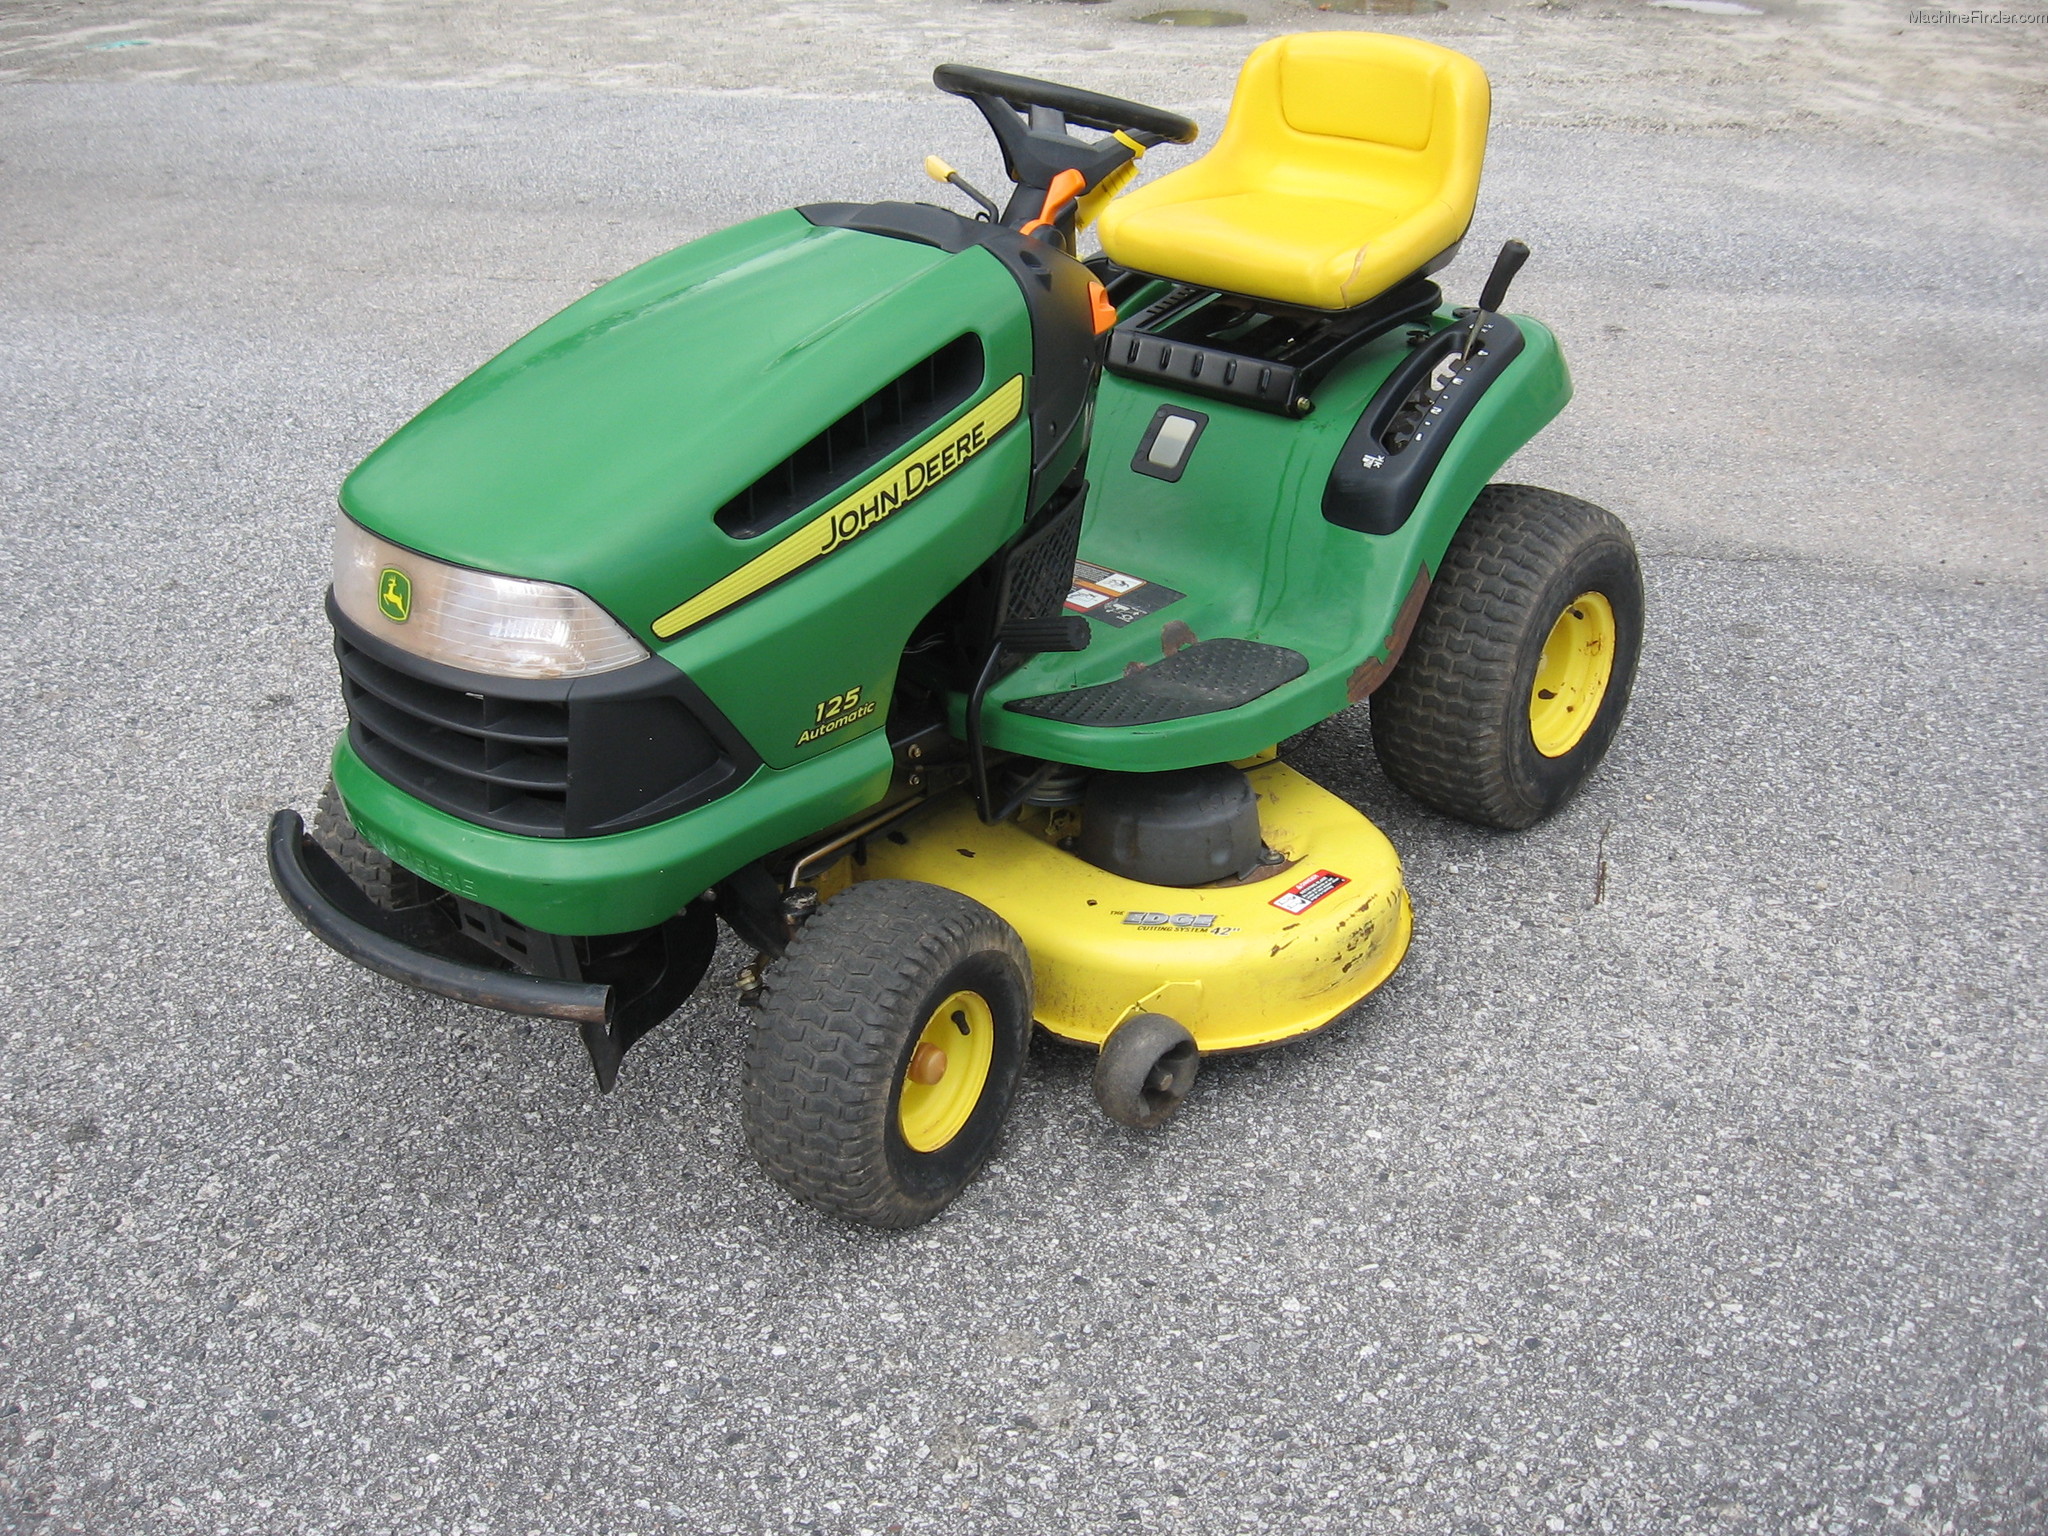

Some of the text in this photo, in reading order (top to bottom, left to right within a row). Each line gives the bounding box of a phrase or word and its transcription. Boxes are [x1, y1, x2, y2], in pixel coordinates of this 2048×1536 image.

[821, 421, 986, 551] JOHN DEERE
[795, 701, 876, 747] Automatic
[815, 685, 862, 724] 125
[1121, 911, 1217, 927] EDGE
